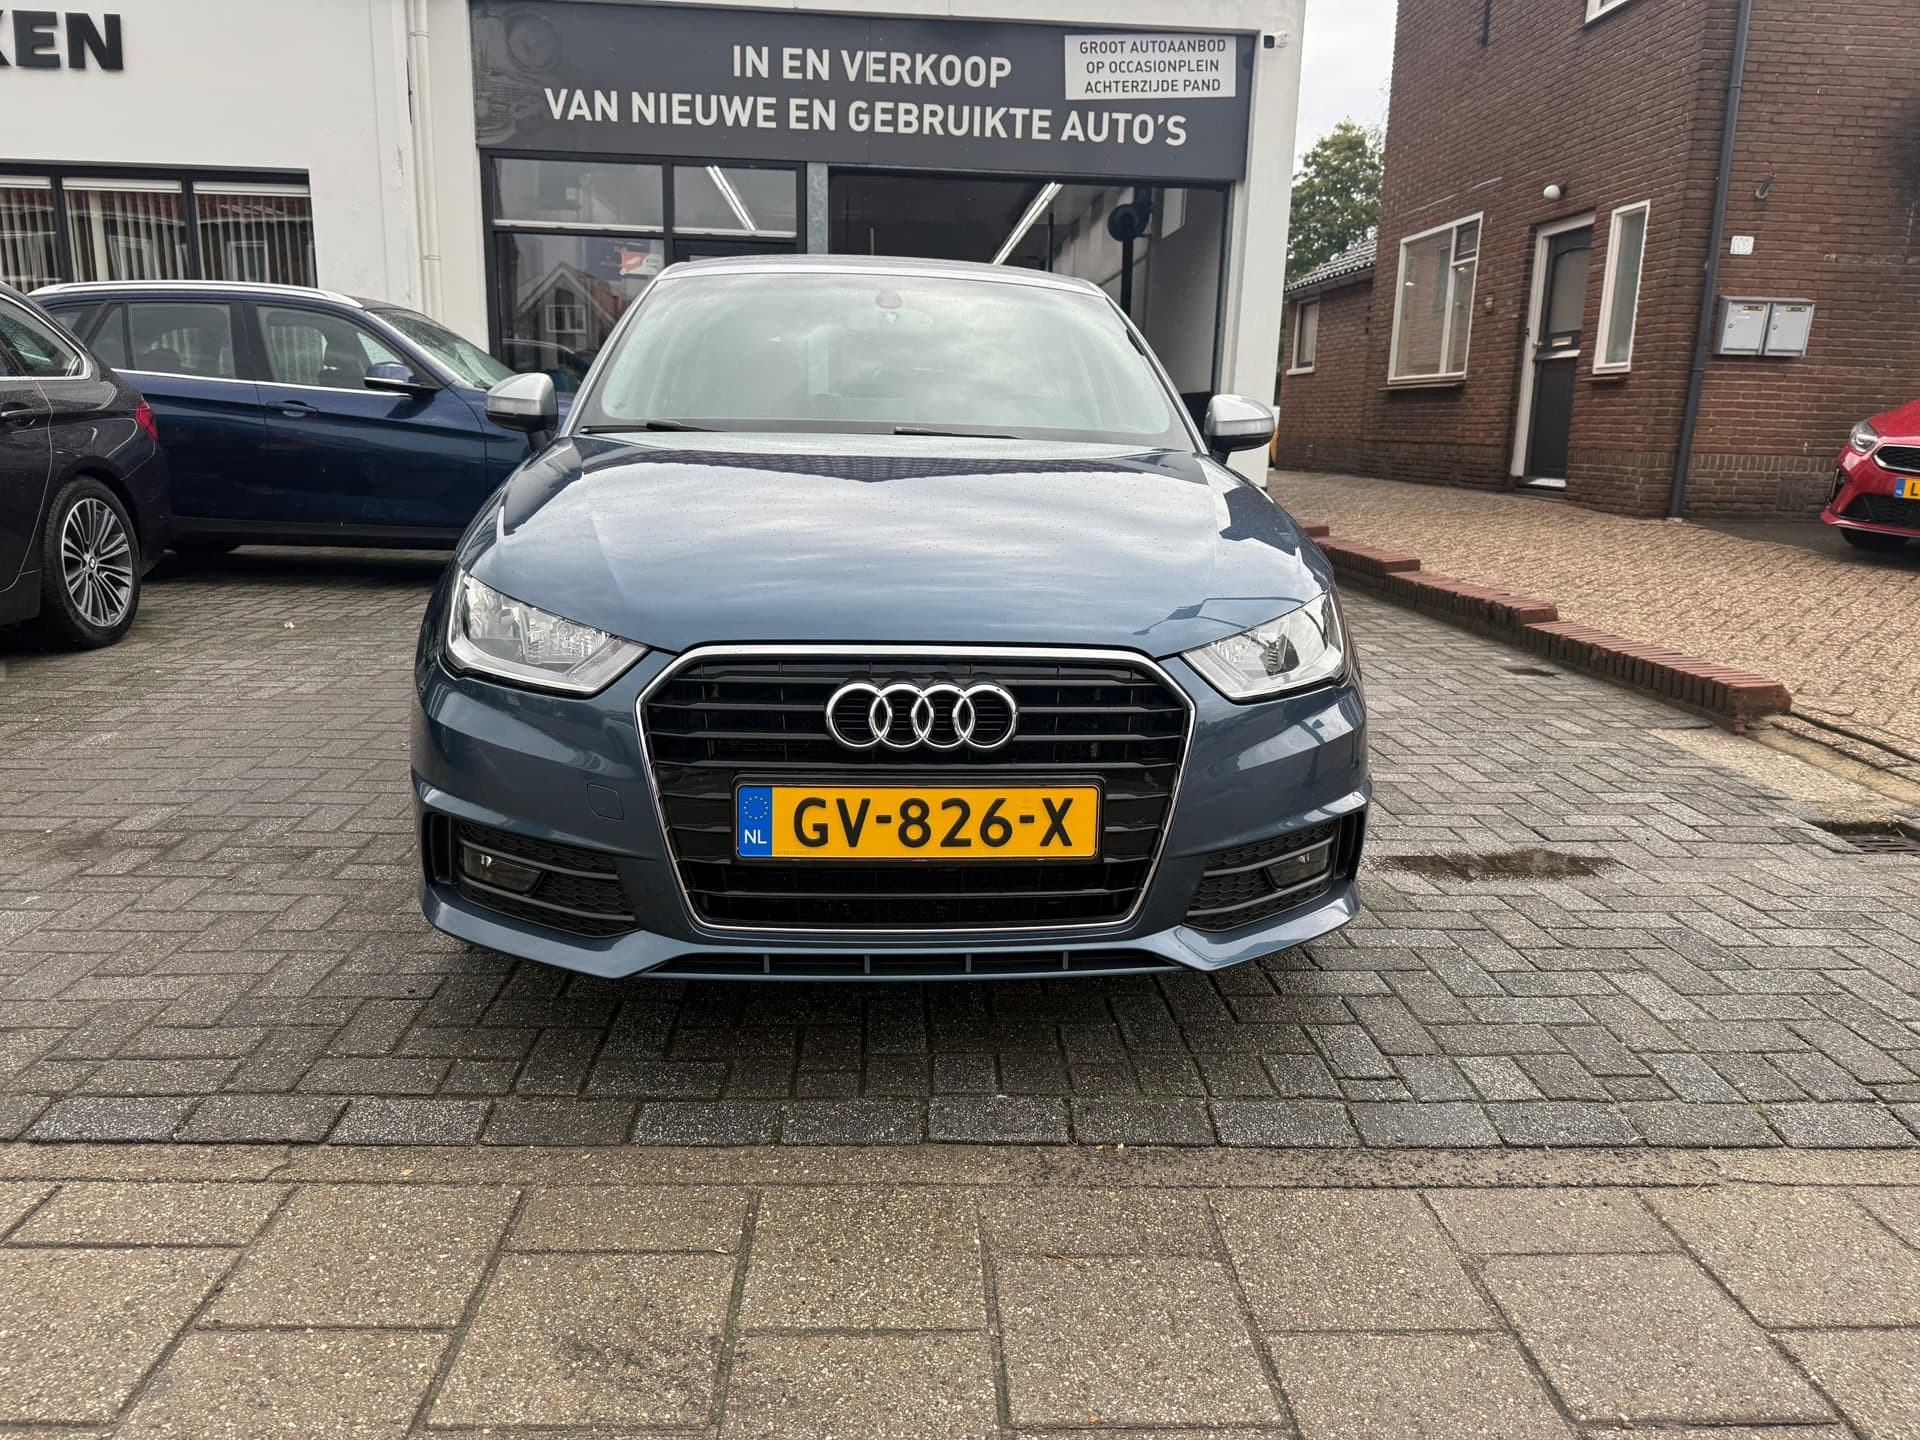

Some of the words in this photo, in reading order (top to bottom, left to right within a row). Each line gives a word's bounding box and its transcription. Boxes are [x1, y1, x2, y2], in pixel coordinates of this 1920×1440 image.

[0, 10, 124, 70] EN
[1079, 41, 1127, 54] GROOT
[1130, 39, 1226, 54] AUTOAANBOD
[733, 45, 769, 78] IN
[782, 47, 830, 81] EN
[840, 50, 1012, 89] VERKOOP
[1086, 61, 1105, 74] OP
[1109, 59, 1219, 74] OCCASIONPLEIN
[1084, 80, 1179, 94] ACHTERZIJDE
[1183, 79, 1221, 92] PAND
[544, 88, 618, 122] VAN
[631, 91, 777, 128] NIEUWE
[788, 97, 836, 131] EN
[848, 100, 1052, 140] GEBRUIKTE
[1060, 110, 1187, 147] AUTO'S
[744, 829, 768, 845] NL
[793, 796, 1074, 849] GV-826-X
